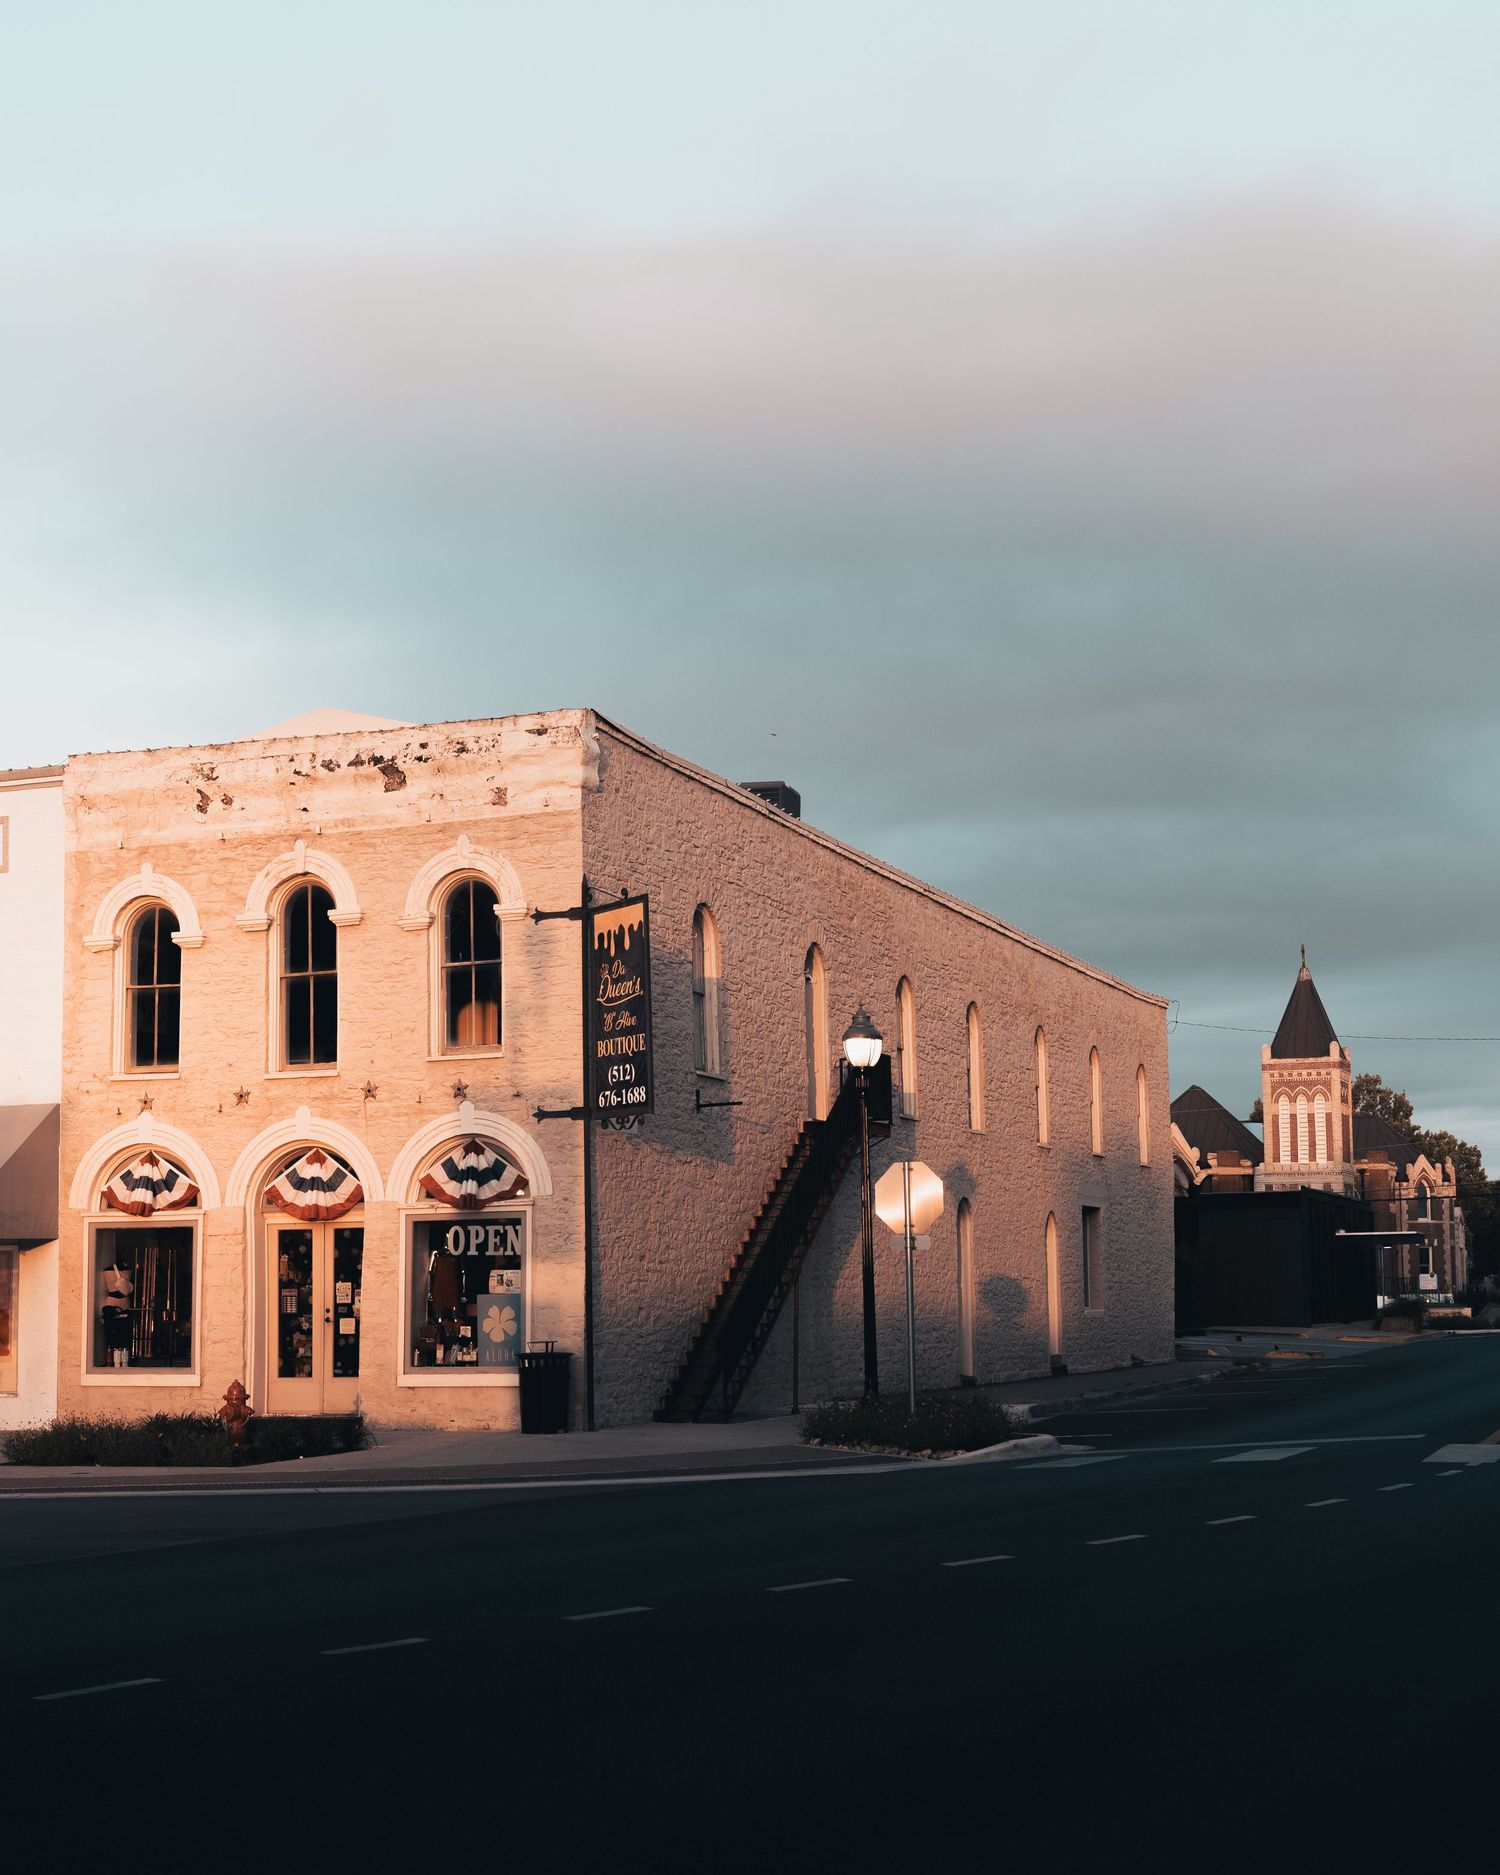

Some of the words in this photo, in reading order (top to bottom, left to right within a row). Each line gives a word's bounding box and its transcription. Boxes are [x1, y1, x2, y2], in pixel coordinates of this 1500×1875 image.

[612, 959, 625, 978] Da
[597, 975, 643, 1006] Queen's
[615, 1011, 637, 1030] Hive
[597, 1033, 646, 1057] BOUTIQUE
[608, 1063, 635, 1086] (512)
[598, 1086, 646, 1108] 676-1688
[448, 1225, 522, 1256] OPEN
[485, 1348, 516, 1362] ALOHA
